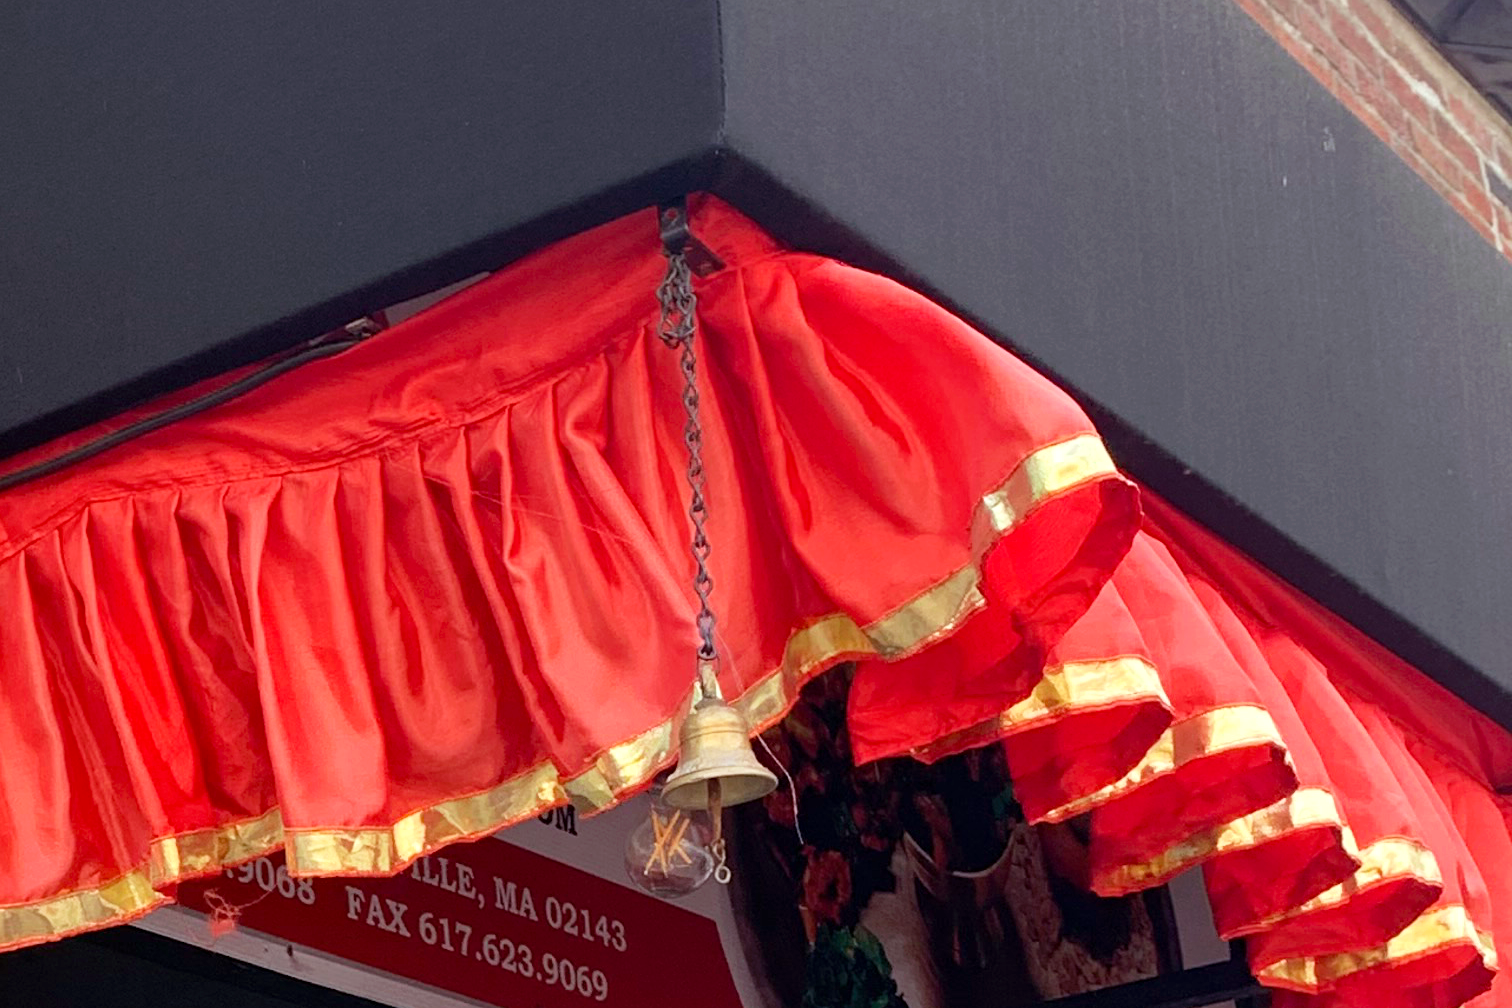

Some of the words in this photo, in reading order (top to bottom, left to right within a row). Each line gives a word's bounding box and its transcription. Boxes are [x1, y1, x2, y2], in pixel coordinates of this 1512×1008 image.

[344, 884, 412, 939] FAX
[417, 911, 609, 1002] 617.623.9069
[492, 875, 539, 923] MA
[544, 895, 628, 952] 02143
